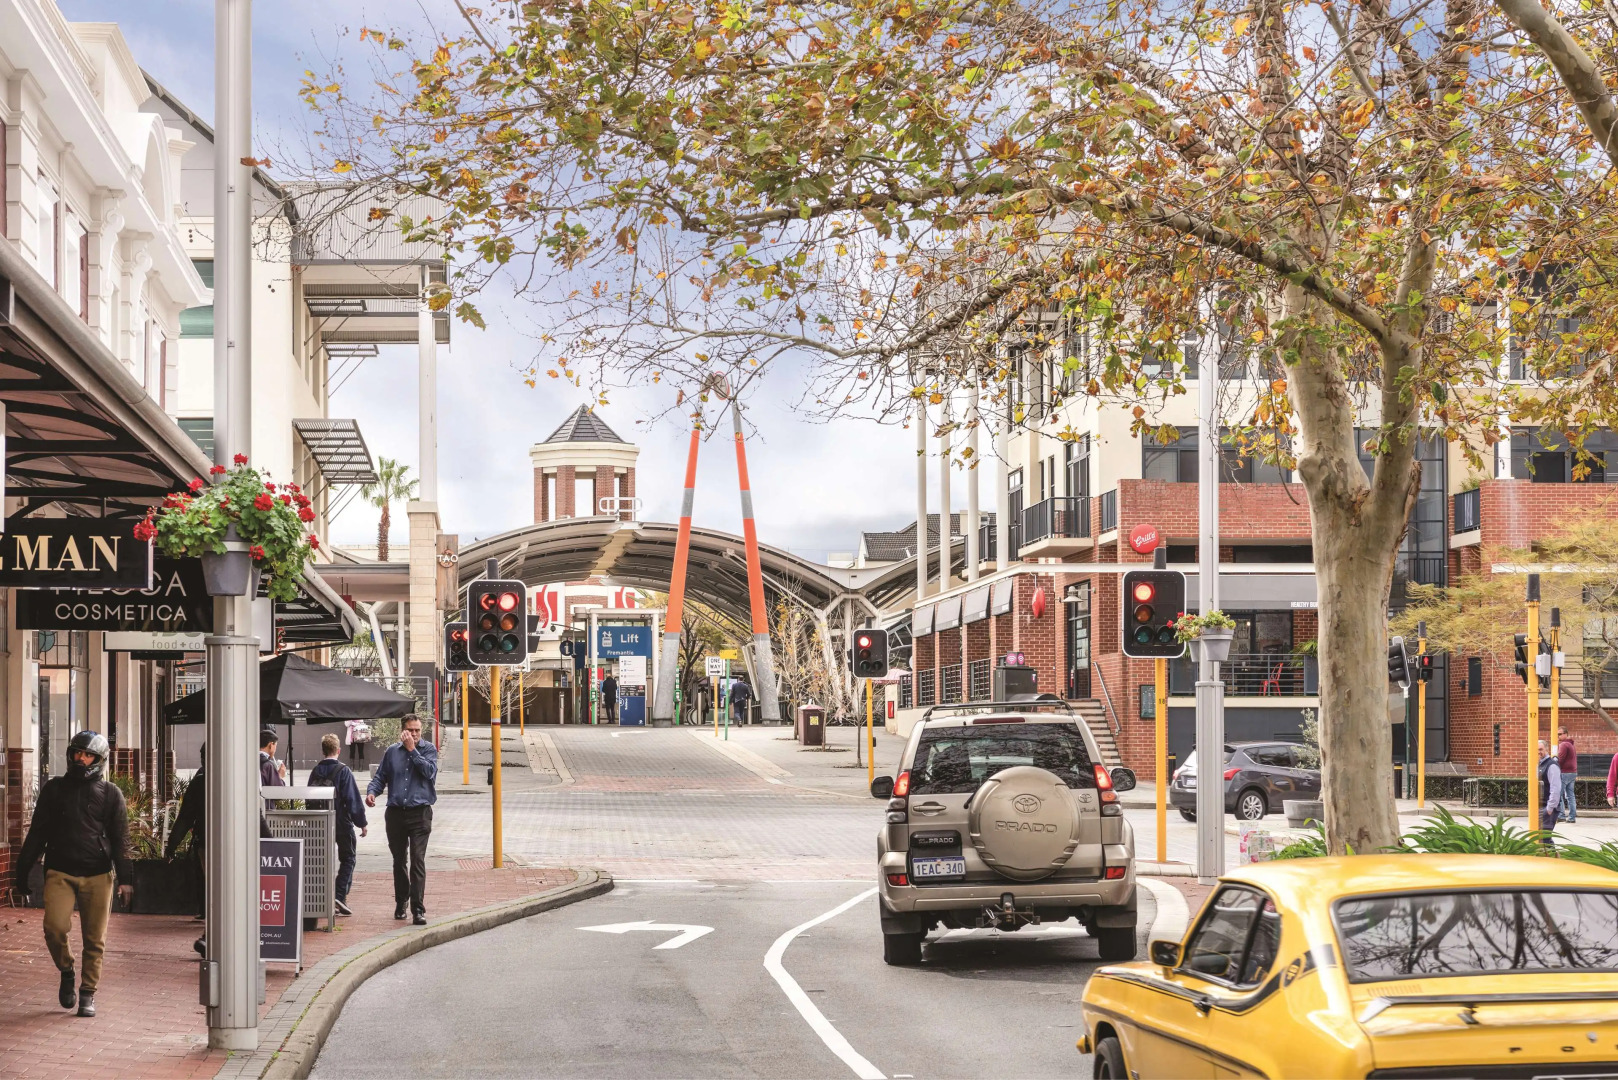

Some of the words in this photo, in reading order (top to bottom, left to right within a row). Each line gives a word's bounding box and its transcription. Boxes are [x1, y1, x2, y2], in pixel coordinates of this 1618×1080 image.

[436, 554, 459, 564] TAO
[55, 603, 187, 621] COSMETICA
[620, 633, 639, 643] Lift
[152, 639, 178, 650] food
[995, 820, 1057, 833] PRADO
[261, 889, 281, 902] LE
[1509, 1044, 1618, 1053] FO
